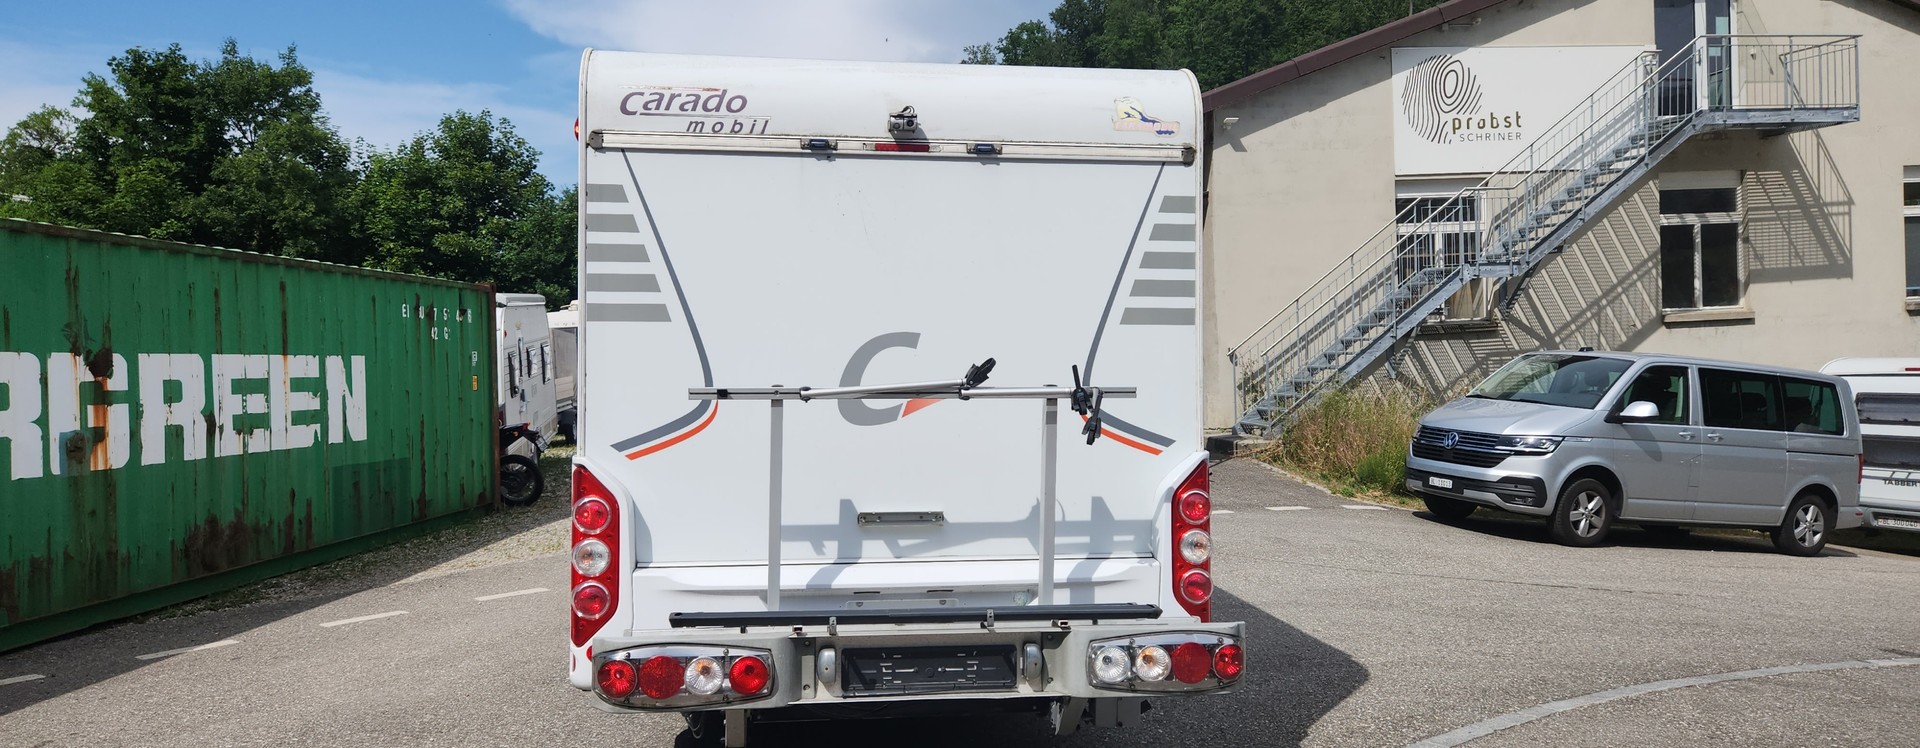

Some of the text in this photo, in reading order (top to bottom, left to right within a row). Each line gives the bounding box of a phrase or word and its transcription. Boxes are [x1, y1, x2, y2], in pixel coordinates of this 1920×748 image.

[686, 119, 769, 135] mobil
[1452, 111, 1522, 134] probst
[1459, 132, 1522, 142] SCHRINER
[1882, 478, 1920, 487] TABBER
